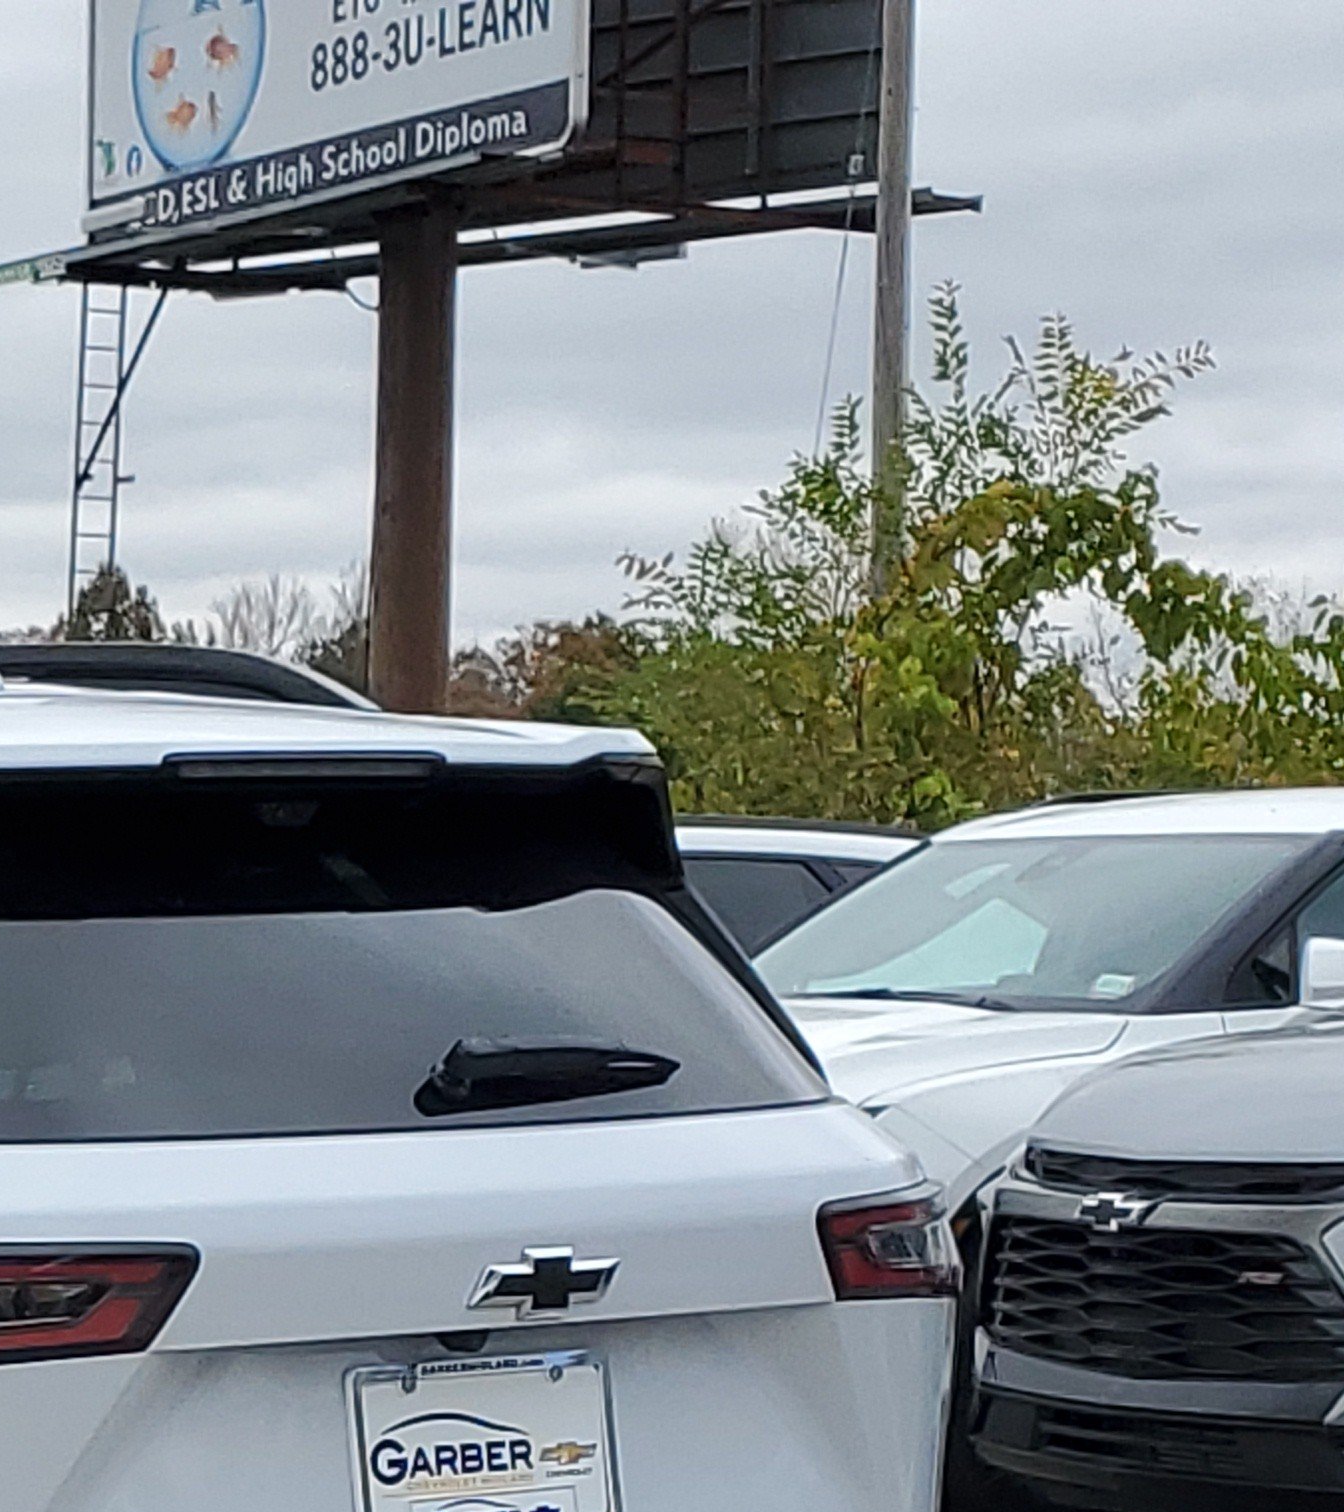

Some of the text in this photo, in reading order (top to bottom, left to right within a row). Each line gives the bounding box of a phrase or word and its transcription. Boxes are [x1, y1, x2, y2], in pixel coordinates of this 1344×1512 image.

[311, 0, 551, 92] 888-3U-LEARN
[226, 171, 247, 203] &
[255, 160, 313, 198] High
[321, 132, 407, 181] School
[414, 109, 528, 158] Diploma
[370, 1438, 534, 1486] GARBER
